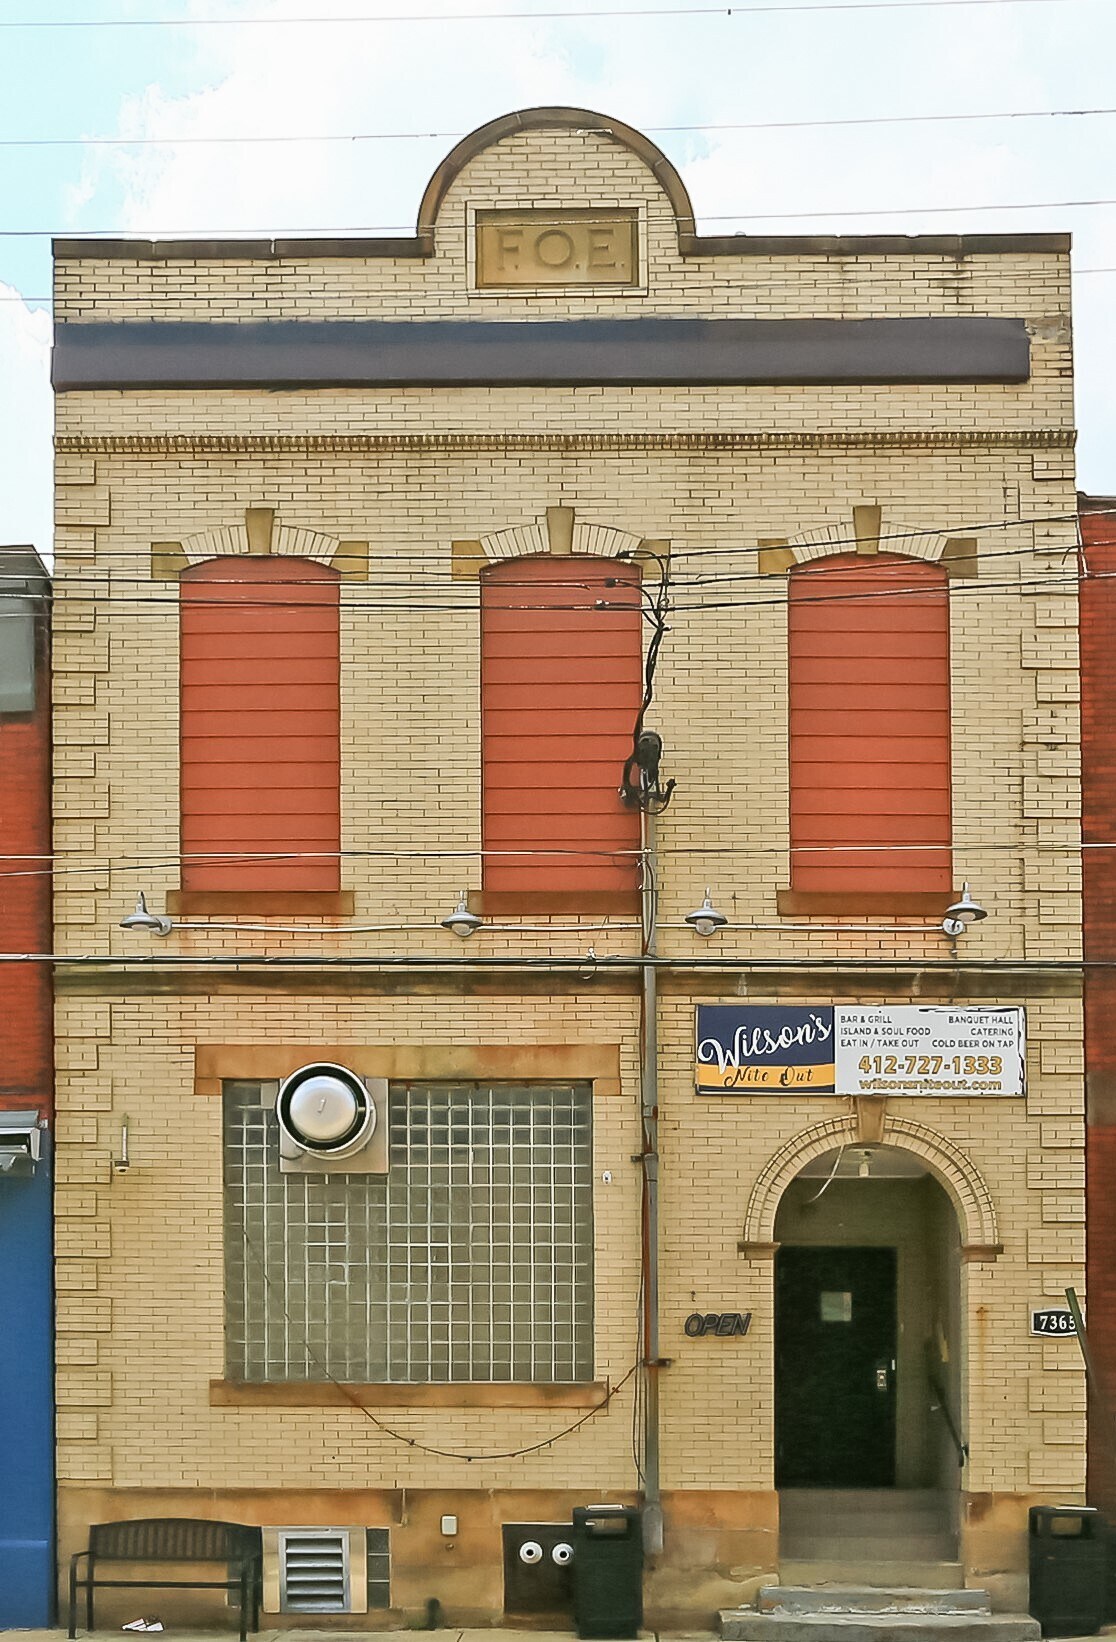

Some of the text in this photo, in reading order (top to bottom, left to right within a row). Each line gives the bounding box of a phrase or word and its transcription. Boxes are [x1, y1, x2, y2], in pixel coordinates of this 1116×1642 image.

[840, 1015, 893, 1024] BAR & GRILL
[948, 1015, 1014, 1025] BANQUET HALL
[840, 1027, 931, 1036] ISLAND & SOUL FOOD
[970, 1027, 1014, 1036] CATERING
[697, 1013, 832, 1075] Wilson's
[840, 1038, 920, 1049] EAT IN / TAKE OUT
[931, 1039, 1014, 1048] COLD BEER ON TAP
[858, 1055, 1003, 1075] 412-727-1333
[723, 1065, 813, 1088] Nite Out
[858, 1077, 1002, 1090] wilsonsniteout.com
[684, 1312, 753, 1338] OPEN
